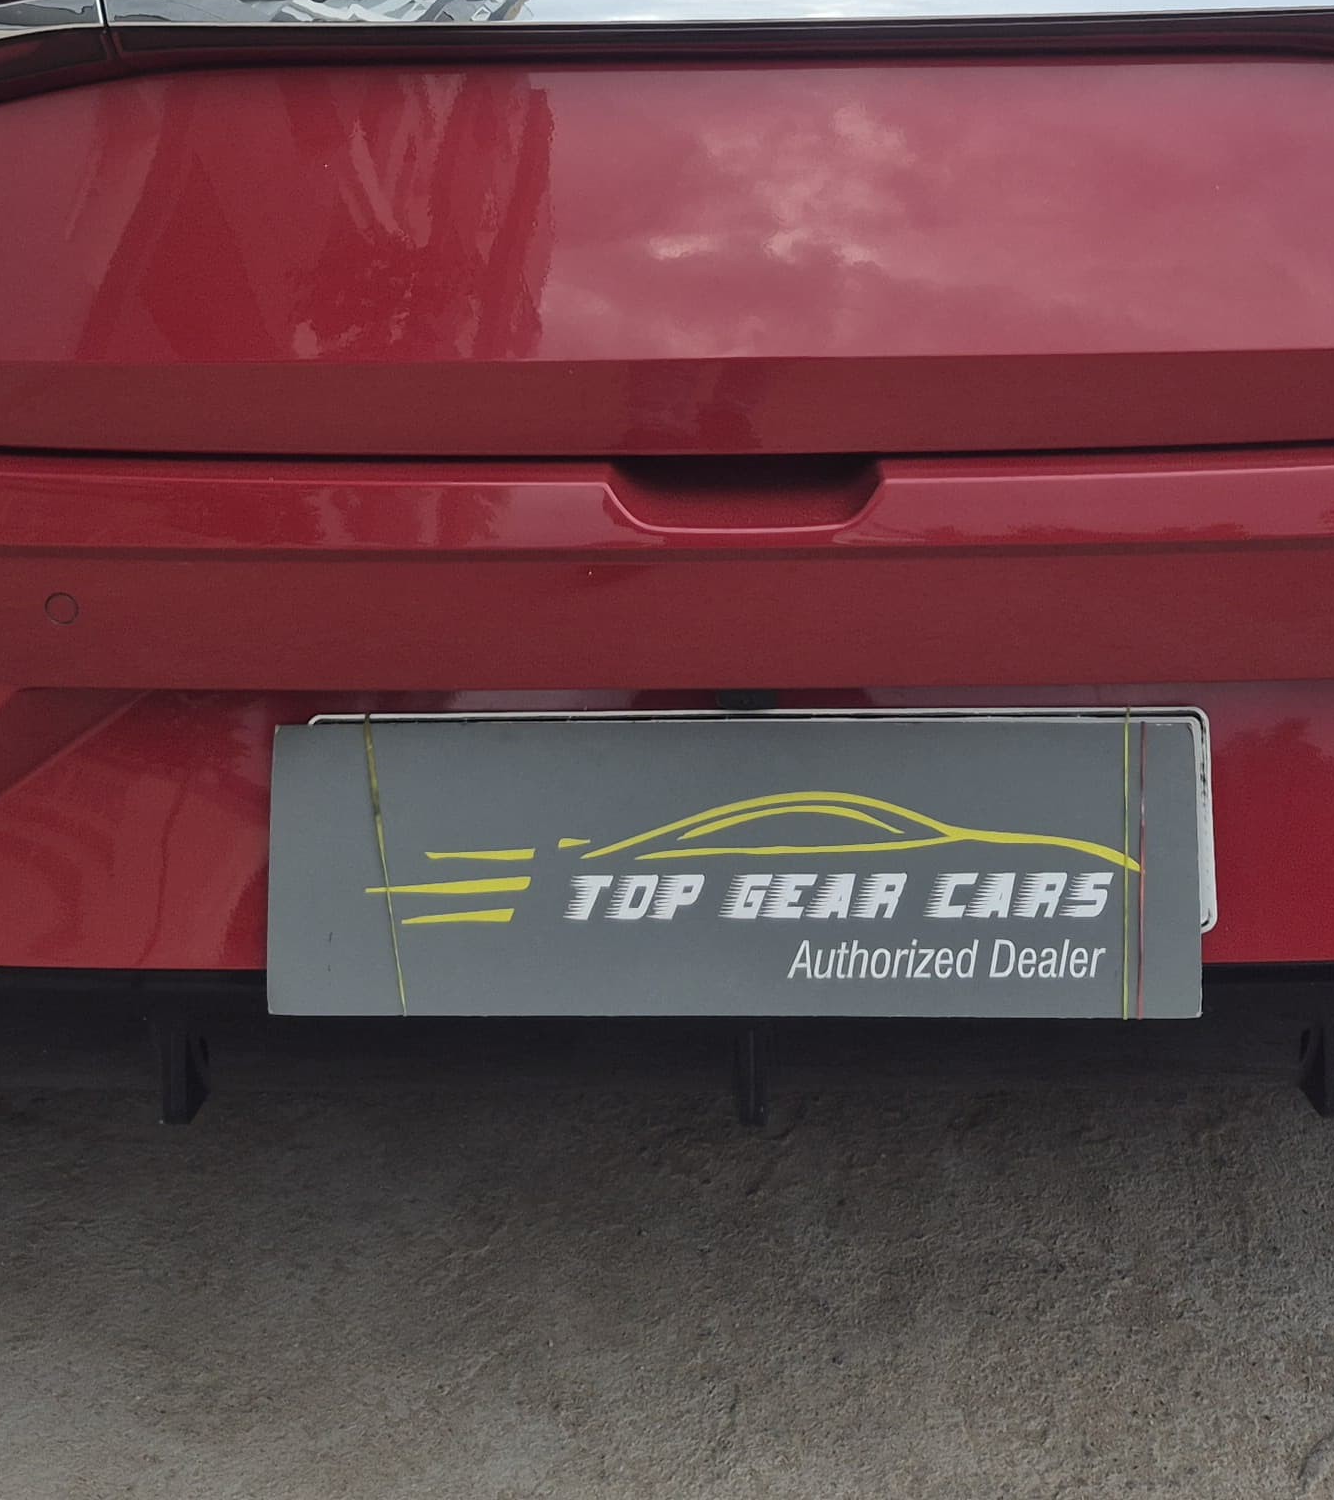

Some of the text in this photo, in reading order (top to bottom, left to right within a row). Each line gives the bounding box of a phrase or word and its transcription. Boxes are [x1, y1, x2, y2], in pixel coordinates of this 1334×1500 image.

[562, 872, 1114, 921] TOP GEAR CARS
[786, 938, 1107, 980] Authorized Dealer
